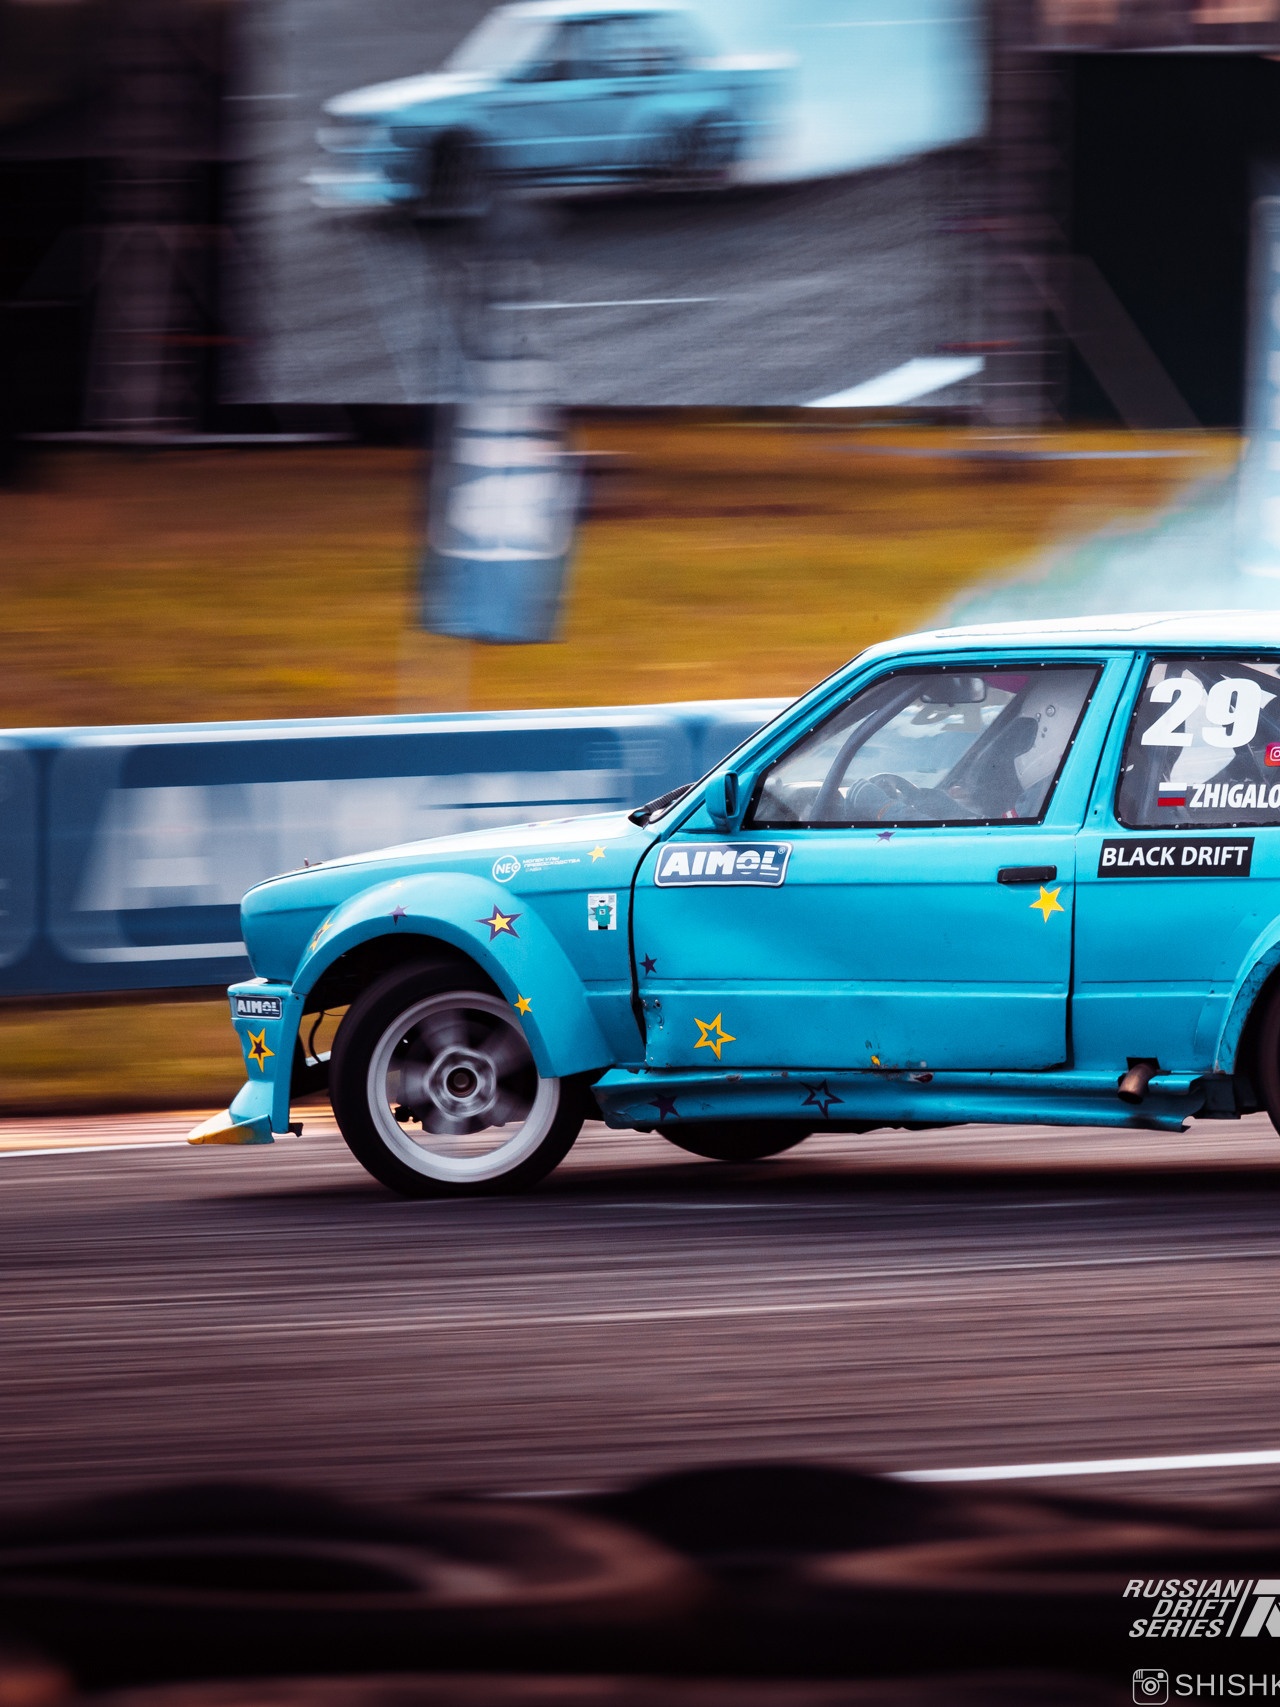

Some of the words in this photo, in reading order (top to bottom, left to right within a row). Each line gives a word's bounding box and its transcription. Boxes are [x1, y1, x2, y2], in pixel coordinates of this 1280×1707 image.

[1141, 677, 1263, 748] 29
[660, 850, 780, 877] AIMOL
[1101, 846, 1176, 867] BLACK
[1181, 846, 1249, 866] DRIFT
[237, 999, 280, 1014] AIMOL
